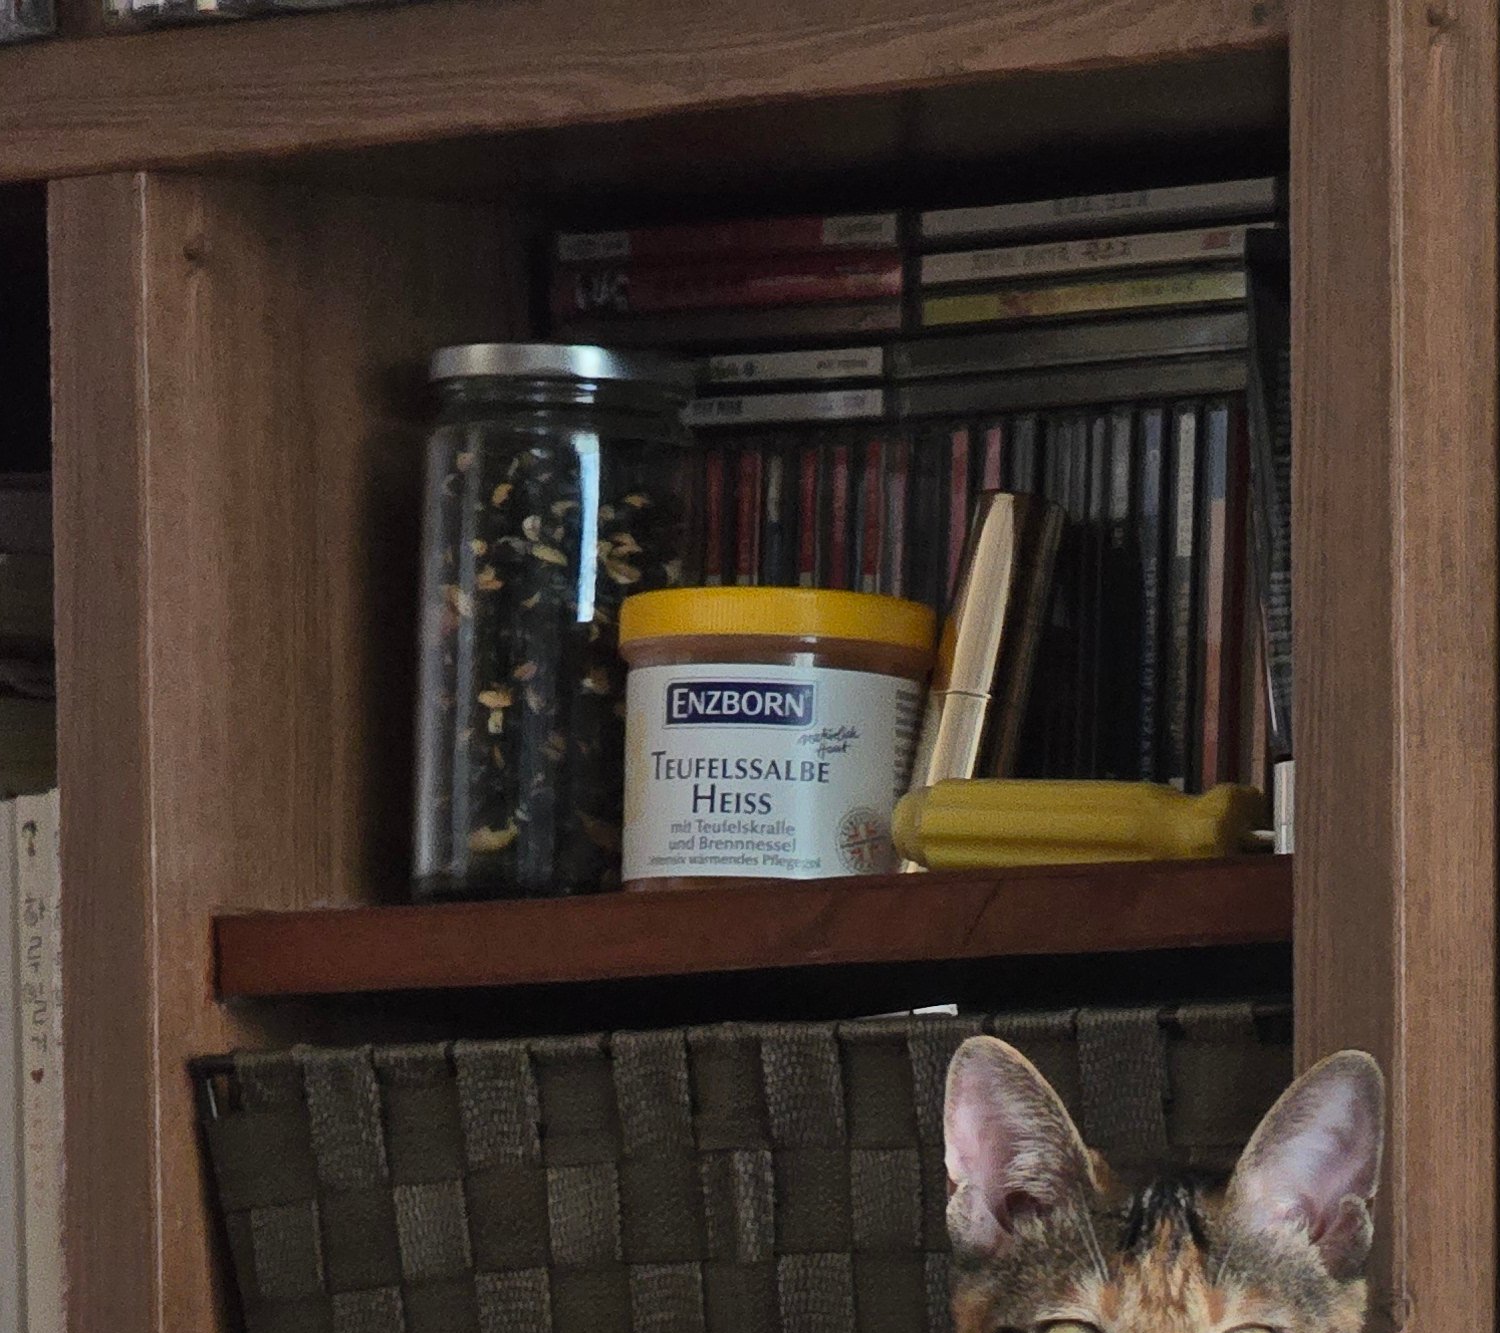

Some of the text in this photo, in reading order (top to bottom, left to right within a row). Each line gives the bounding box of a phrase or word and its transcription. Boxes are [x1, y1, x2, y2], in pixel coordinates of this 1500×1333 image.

[673, 688, 804, 718] ENZBORN
[651, 751, 830, 783] TEUFELSSALBE
[692, 784, 772, 815] HEISS
[671, 819, 796, 836] mit Teufelskralle
[668, 837, 796, 852] und Brennnessel
